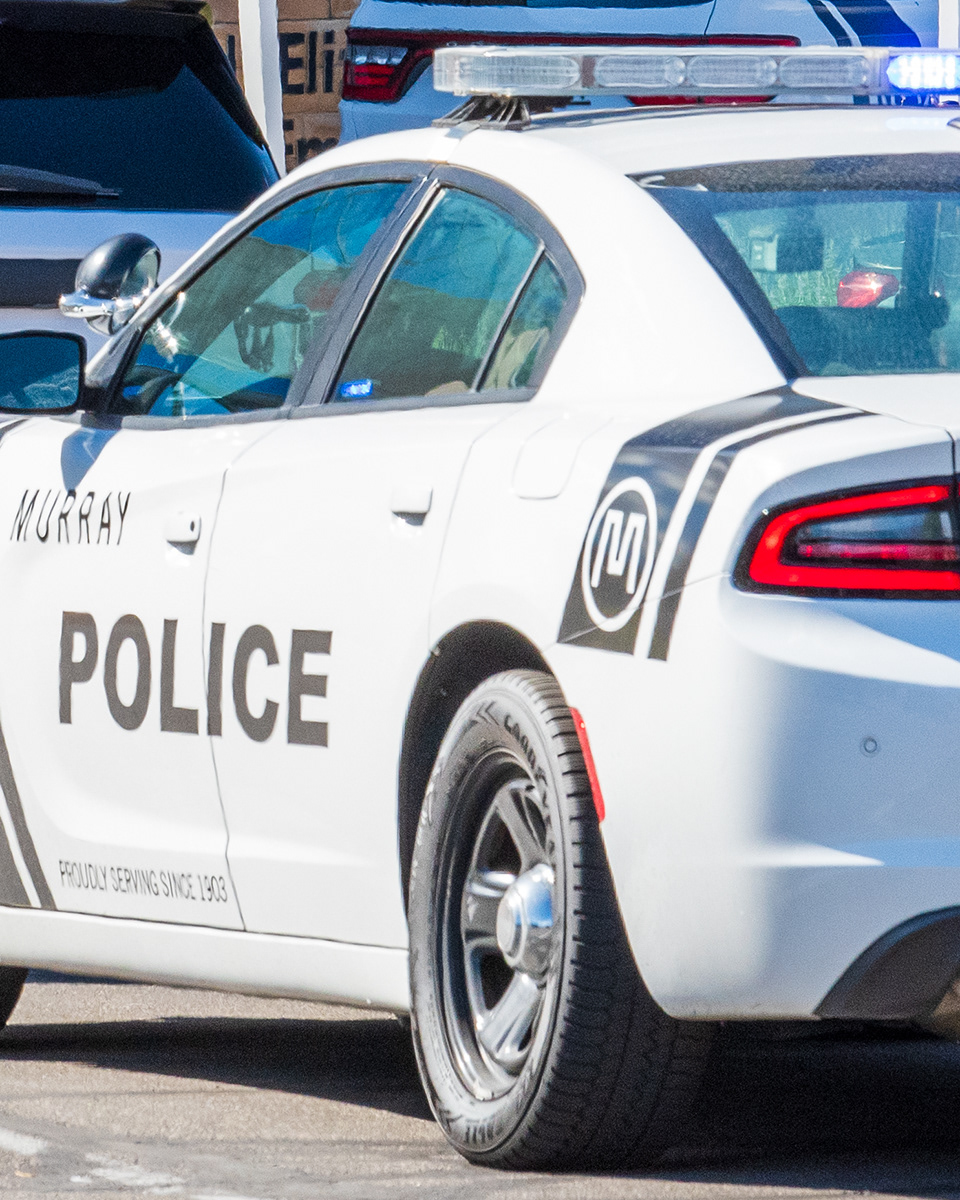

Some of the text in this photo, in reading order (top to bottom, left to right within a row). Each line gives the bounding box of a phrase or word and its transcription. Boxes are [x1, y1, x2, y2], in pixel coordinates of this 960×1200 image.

[10, 489, 131, 545] MURRAY
[59, 610, 333, 748] POLICE
[58, 859, 228, 904] PROUDLY SERVING SINCE 1903
